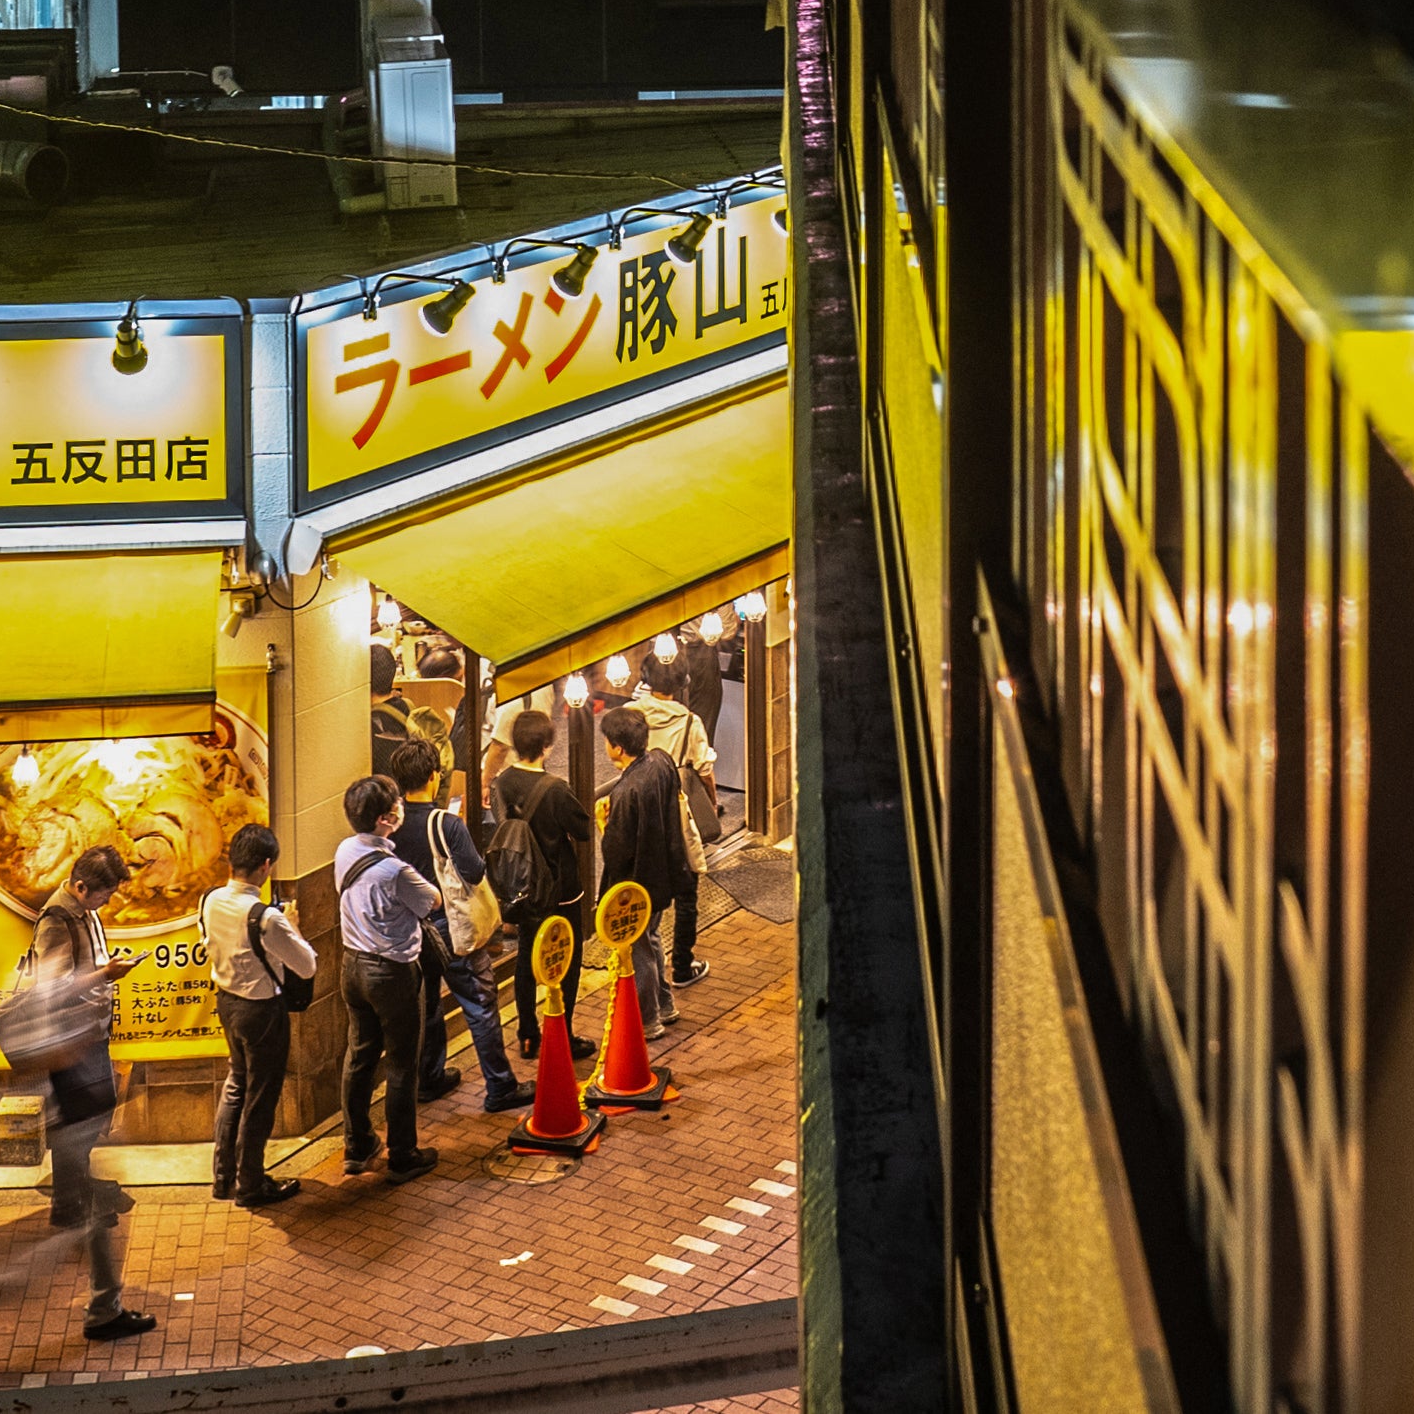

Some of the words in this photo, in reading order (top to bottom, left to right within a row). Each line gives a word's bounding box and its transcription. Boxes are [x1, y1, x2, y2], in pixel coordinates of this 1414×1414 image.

[334, 227, 748, 450] ラーメン豚山
[11, 436, 210, 485] 五反田店
[132, 1012, 168, 1025] 汁なし
